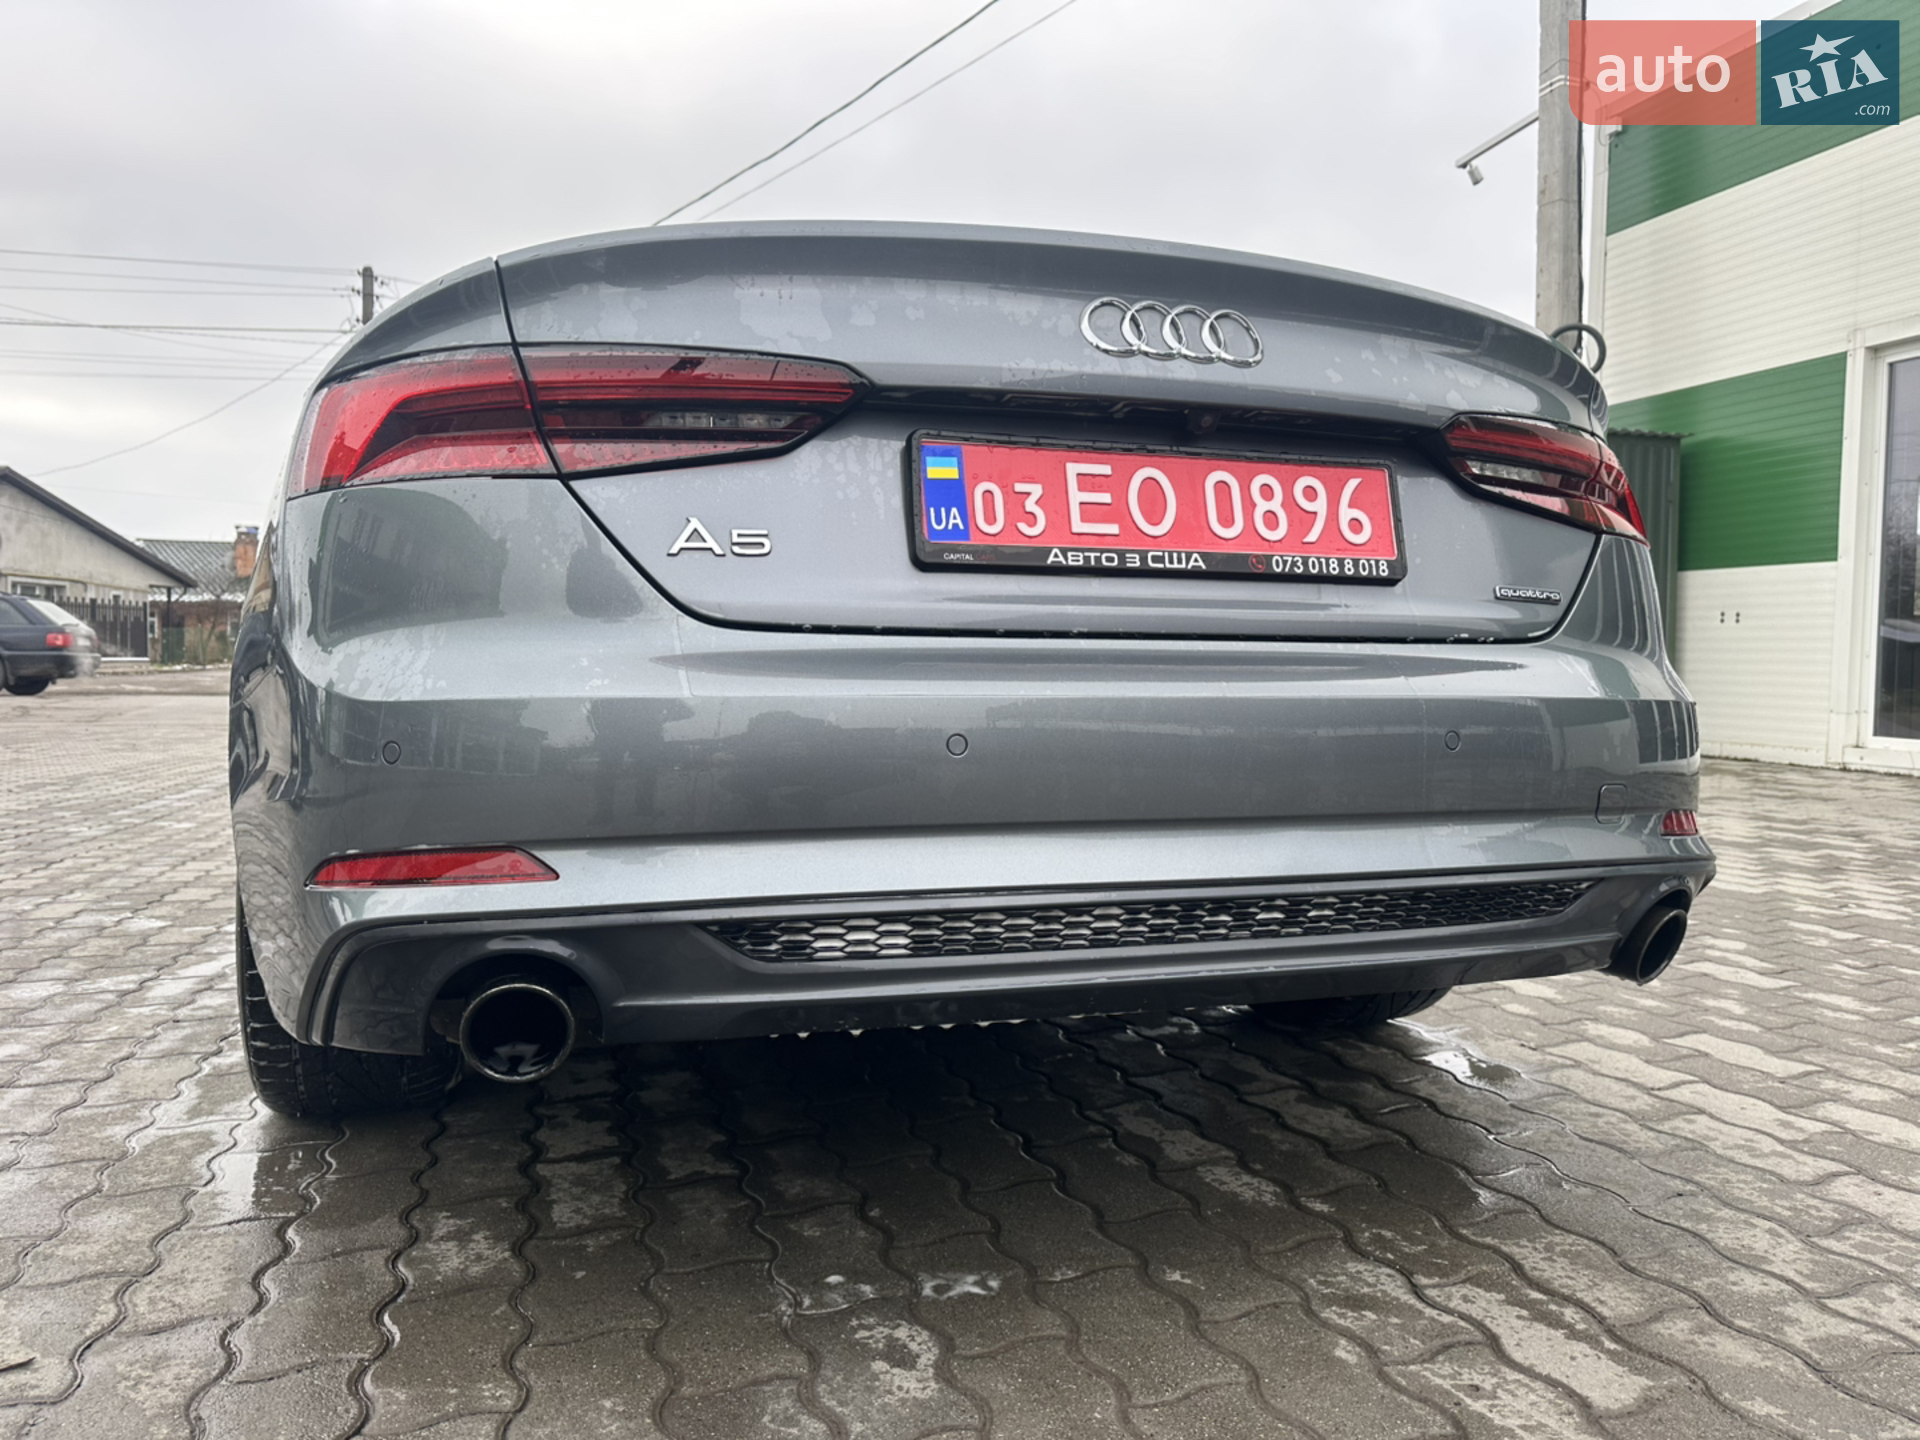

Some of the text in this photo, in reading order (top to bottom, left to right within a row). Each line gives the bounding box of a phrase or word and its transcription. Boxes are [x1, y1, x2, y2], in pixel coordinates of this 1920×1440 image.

[973, 462, 1373, 545] 03 EO 0896
[929, 506, 965, 531] UA
[666, 517, 772, 557] A5
[943, 552, 974, 561] CAPITAL
[1148, 551, 1206, 570] США
[1272, 556, 1389, 576] 073 018 8 018
[1500, 587, 1561, 600] quattro
